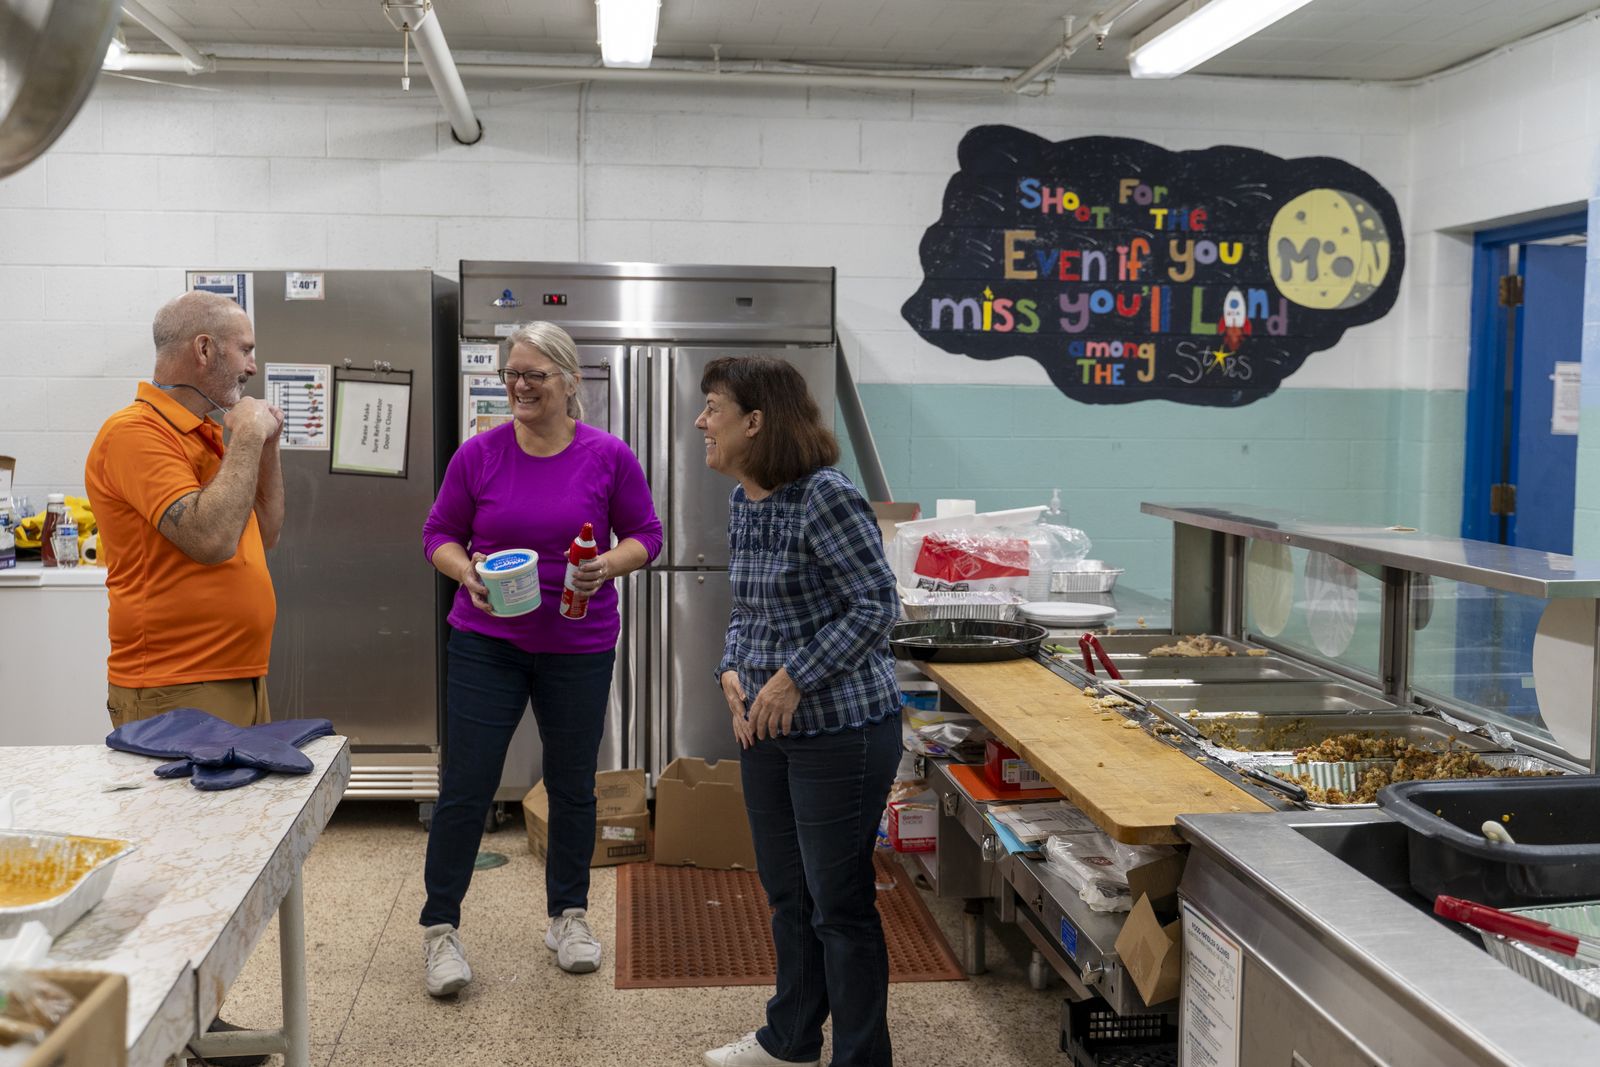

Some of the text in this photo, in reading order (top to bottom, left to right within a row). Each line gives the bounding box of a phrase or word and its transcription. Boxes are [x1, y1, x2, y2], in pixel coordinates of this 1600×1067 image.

[1116, 236, 1150, 281] if
[1167, 238, 1244, 283] you
[931, 284, 1041, 333] miss
[1058, 285, 1172, 334] you'll
[1068, 341, 1157, 383] among
[1075, 358, 1126, 386] THE
[361, 402, 371, 446] Please Make
[374, 398, 383, 437] Refrigerator
[385, 403, 393, 425] Closed
[383, 433, 391, 450] Door
